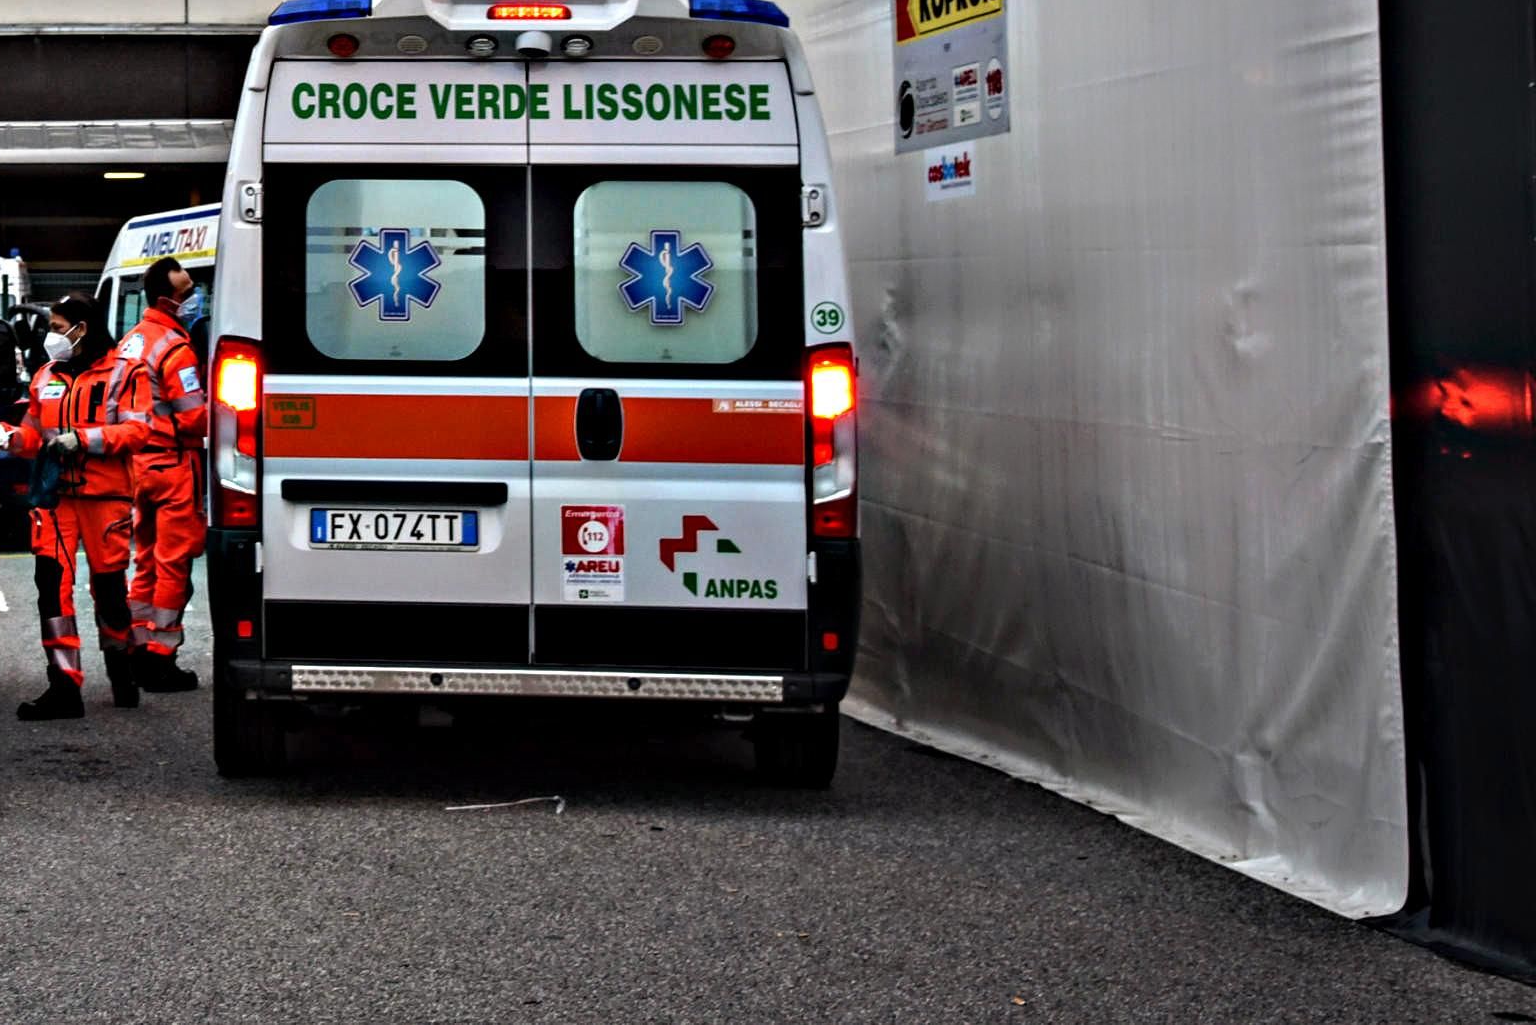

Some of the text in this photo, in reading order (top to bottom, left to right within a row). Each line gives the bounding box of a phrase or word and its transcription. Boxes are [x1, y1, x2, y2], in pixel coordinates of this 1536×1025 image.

[291, 82, 771, 121] CROCE VERDE LISSONESE
[816, 309, 839, 327] 39
[587, 532, 604, 541] 112
[576, 560, 620, 573] AREU
[704, 578, 779, 599] ANPAS
